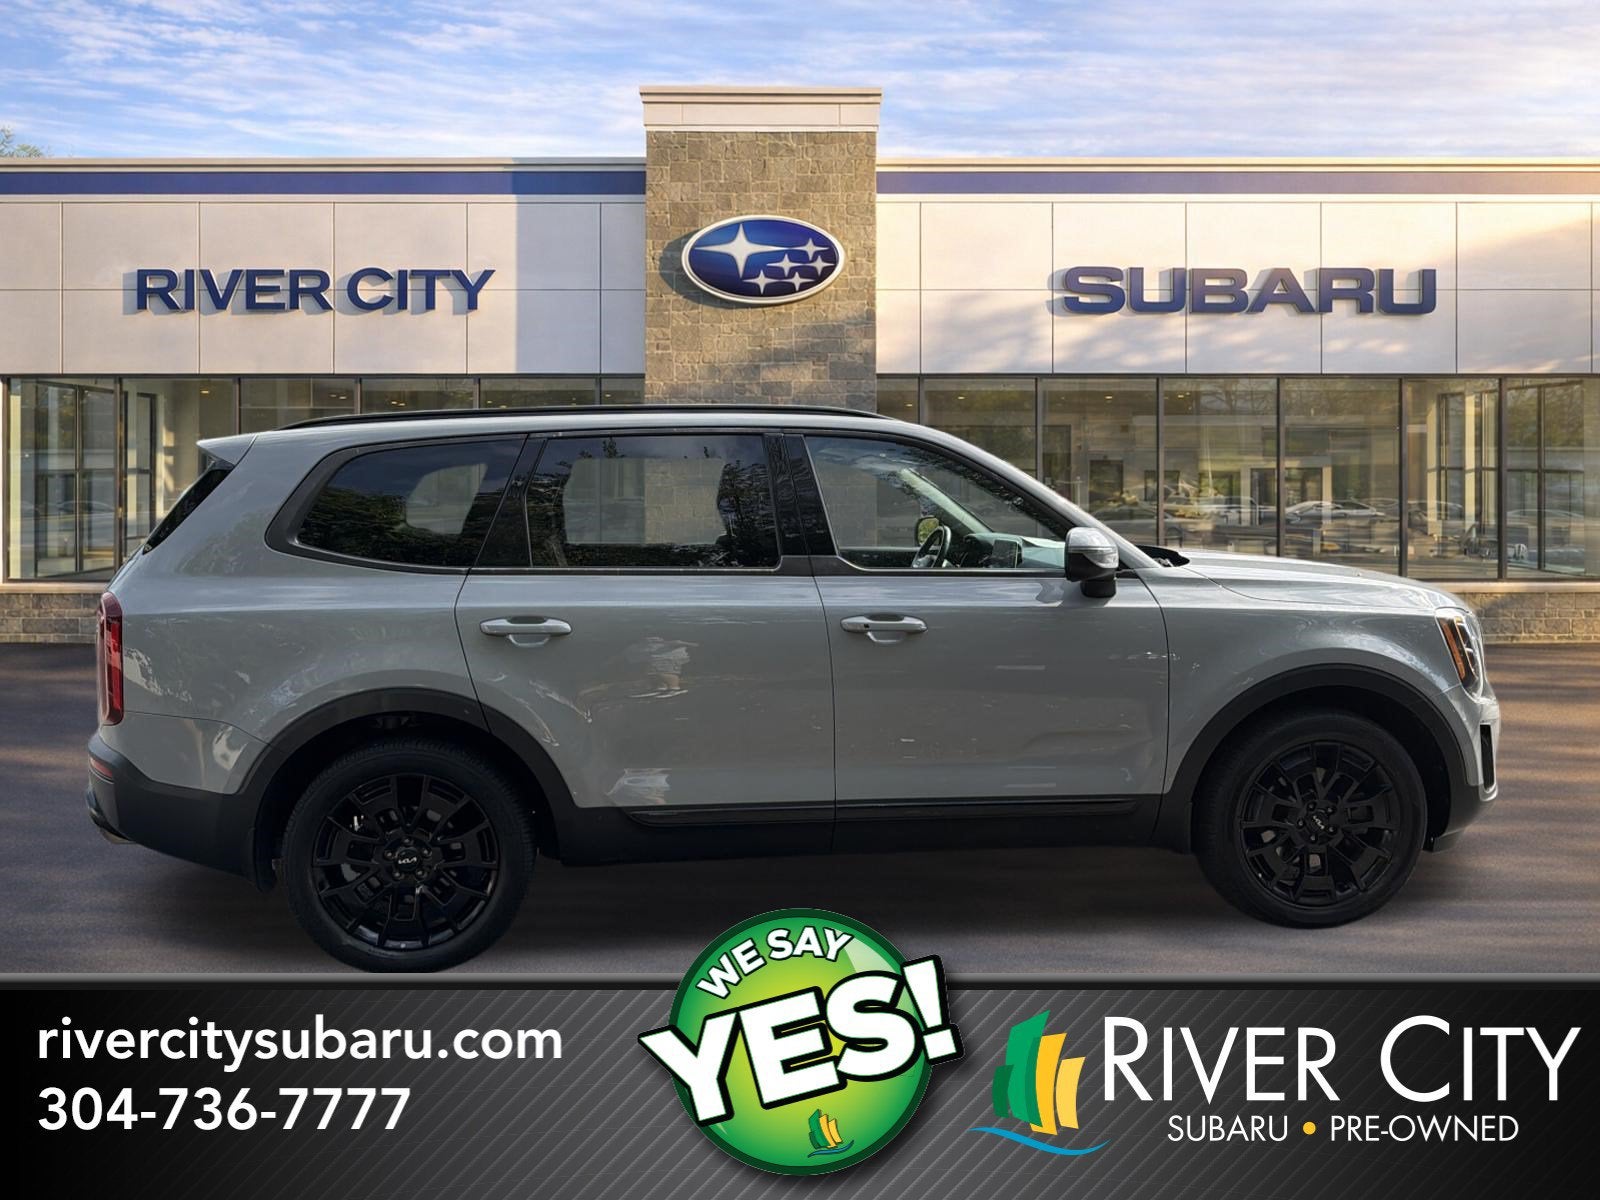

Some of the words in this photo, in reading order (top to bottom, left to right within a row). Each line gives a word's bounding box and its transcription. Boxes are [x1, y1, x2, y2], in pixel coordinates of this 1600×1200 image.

[136, 269, 334, 311] RIVER
[346, 267, 496, 311] CITY
[1063, 266, 1437, 314] SUBARU
